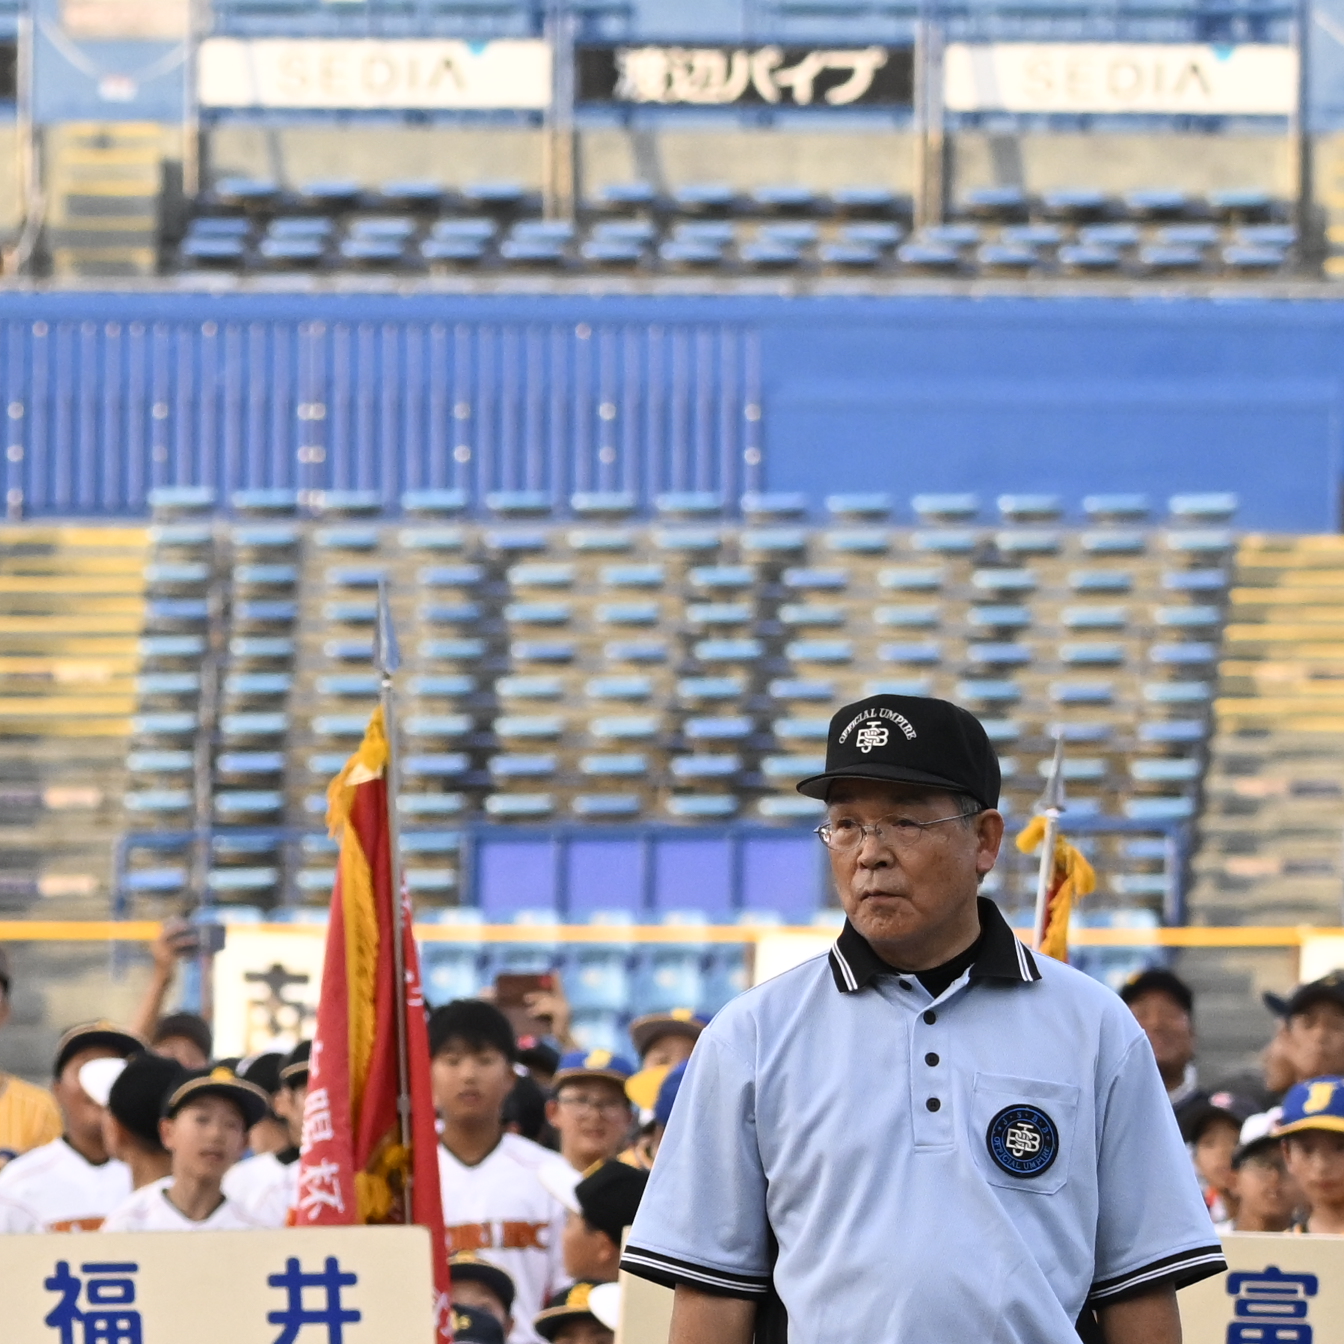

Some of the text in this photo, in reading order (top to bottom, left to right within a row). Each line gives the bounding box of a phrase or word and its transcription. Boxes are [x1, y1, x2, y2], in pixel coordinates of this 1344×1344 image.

[277, 52, 467, 92] SEDIA
[1021, 57, 1212, 94] SEDIA
[838, 707, 917, 744] OFFICIAL UMPIRE
